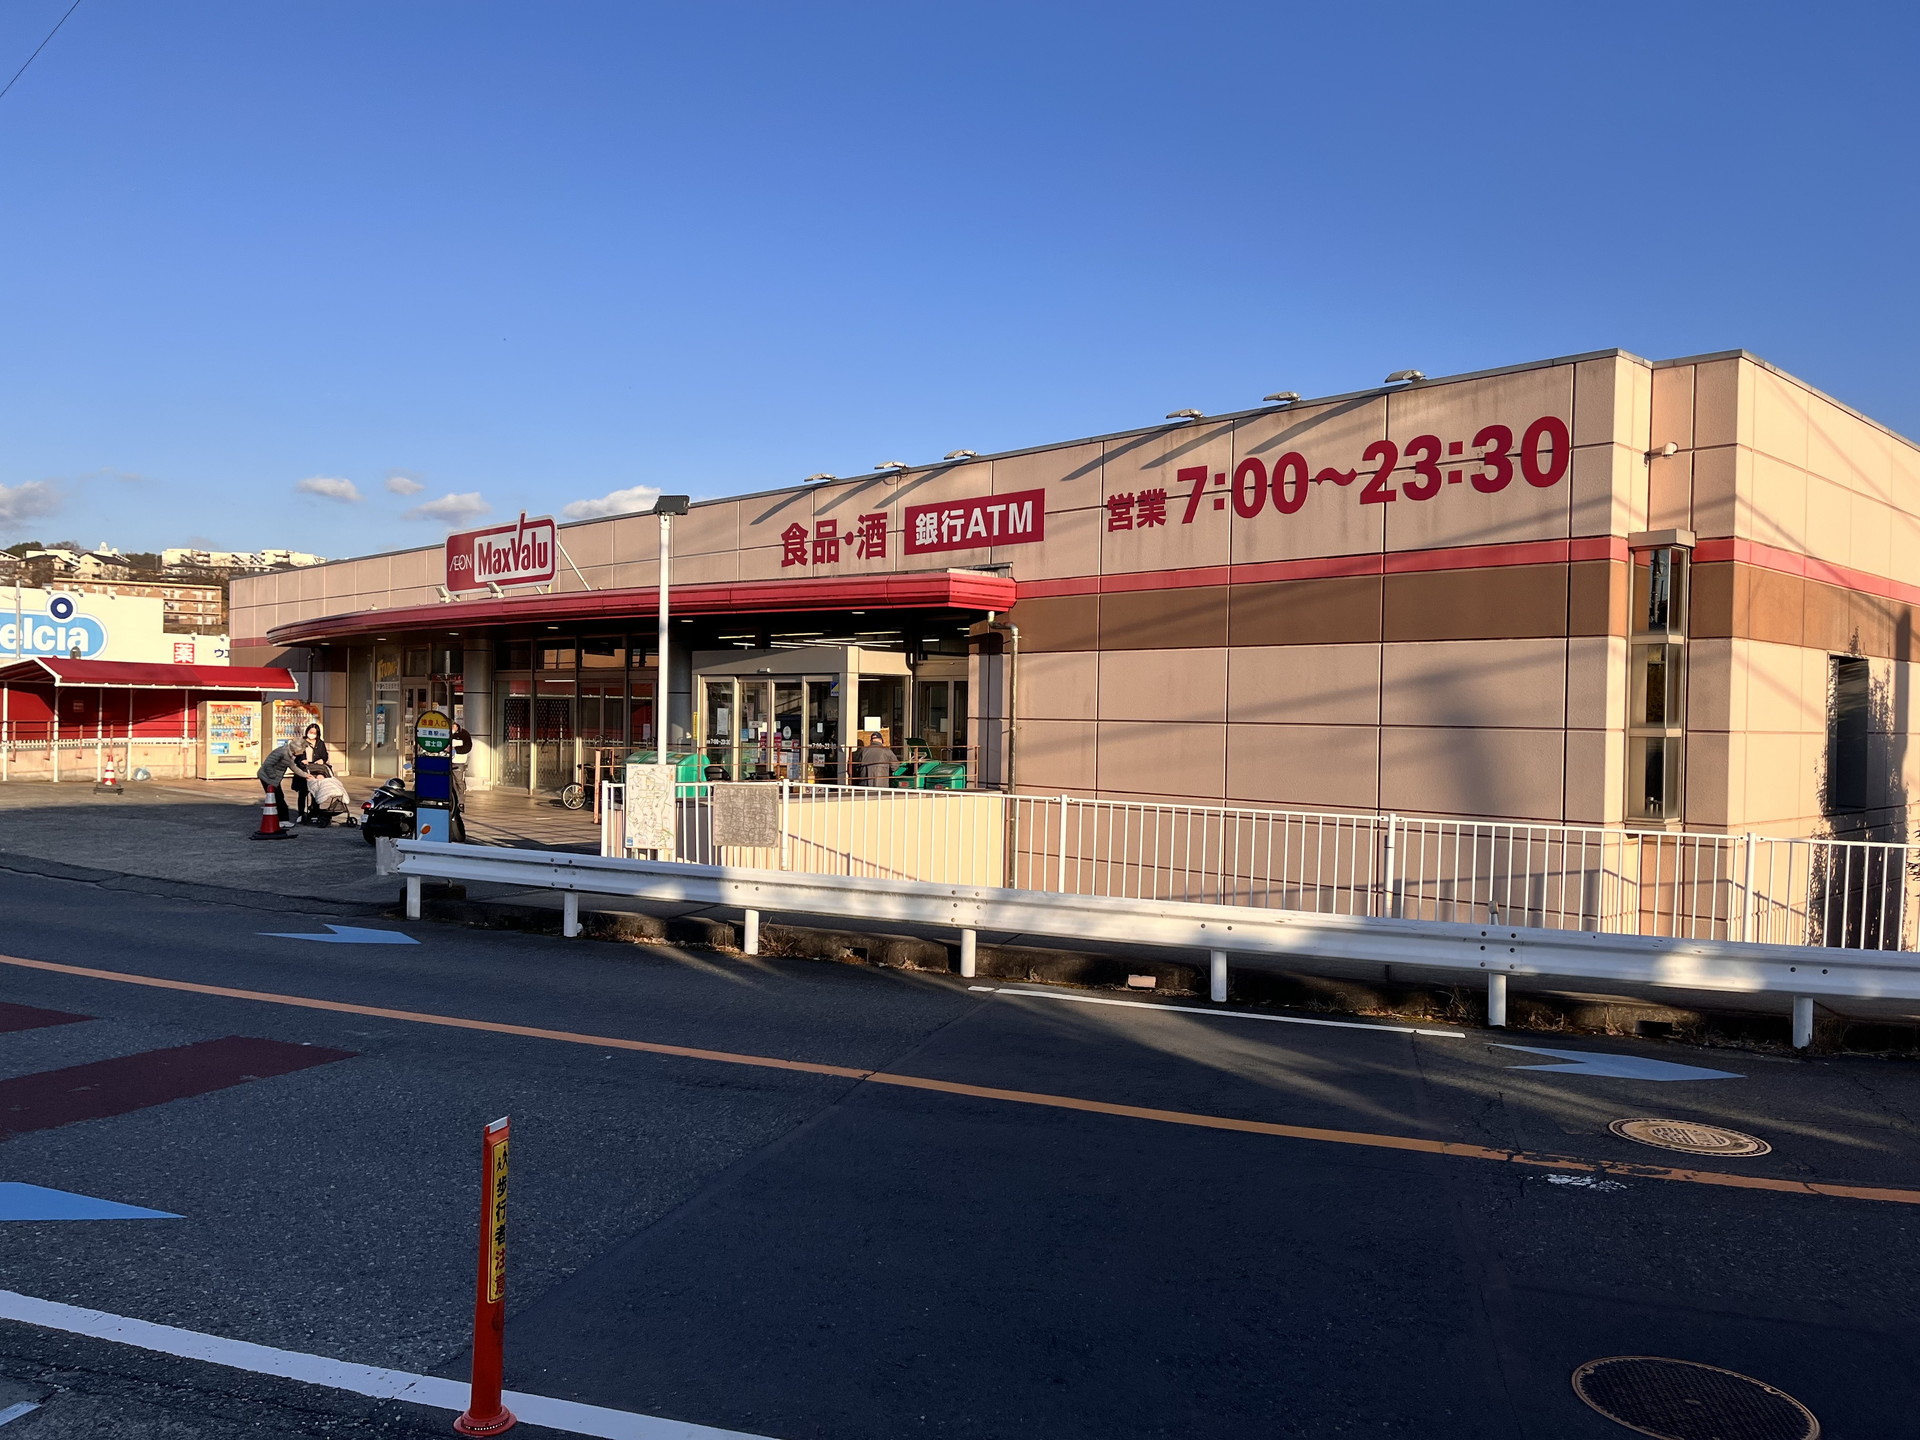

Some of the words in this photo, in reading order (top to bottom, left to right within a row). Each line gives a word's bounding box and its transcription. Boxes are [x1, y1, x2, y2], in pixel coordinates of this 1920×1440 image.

[915, 500, 1033, 546] 銀行ATM
[1107, 488, 1168, 532] 営業
[478, 513, 548, 576] MaxValu
[781, 512, 888, 568] 食品・酒
[0, 616, 89, 652] elcia
[174, 643, 194, 663] 薬
[494, 1176, 507, 1295] 歩行者注意
